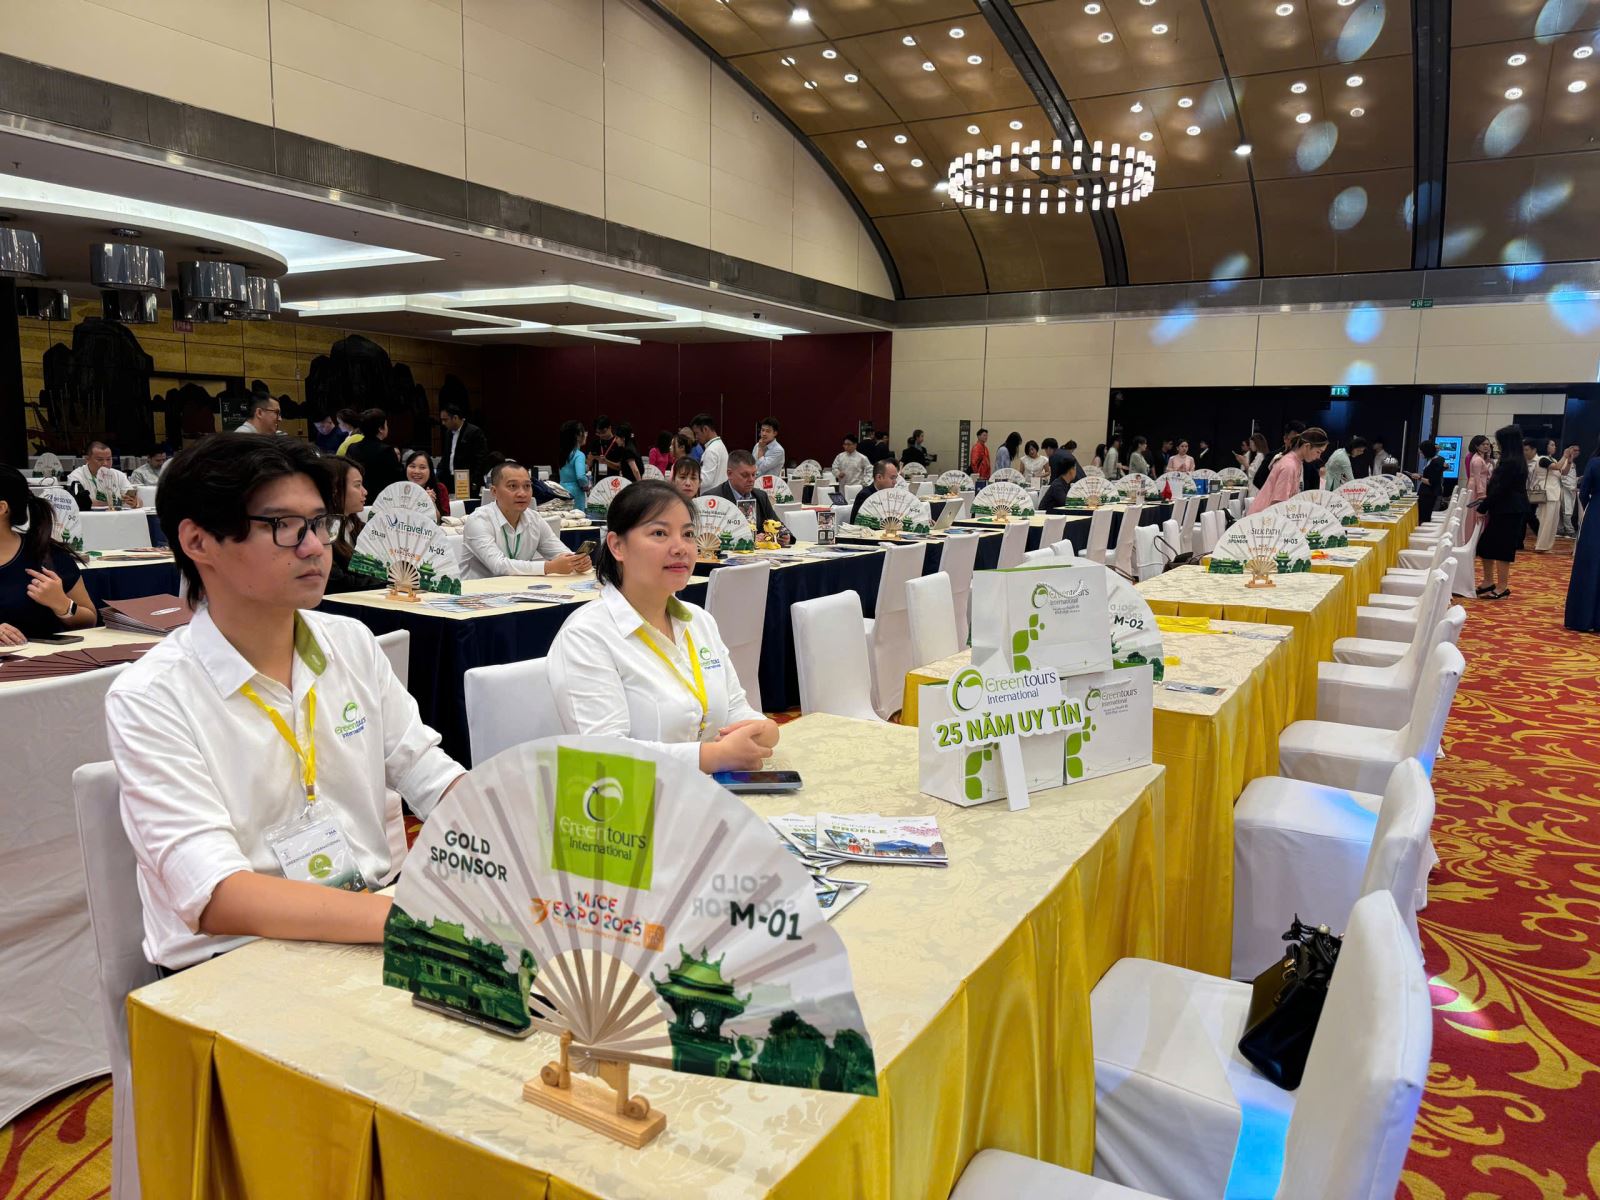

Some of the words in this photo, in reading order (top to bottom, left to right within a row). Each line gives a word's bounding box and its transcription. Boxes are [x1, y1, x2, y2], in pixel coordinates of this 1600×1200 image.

[428, 545, 445, 556] N-02
[1113, 614, 1144, 631] M-02
[984, 671, 1057, 693] Greentours
[987, 688, 1040, 705] International
[935, 722, 963, 748] 25
[966, 711, 1016, 742] NĂM
[1017, 707, 1045, 733] UY
[1046, 699, 1083, 728] TÍN
[444, 829, 491, 856] GOLD
[559, 815, 647, 850] Greentours
[569, 836, 632, 861] International
[430, 845, 508, 883] SPONSOR
[576, 890, 619, 914] MICE
[552, 900, 601, 926] EXPO
[602, 913, 643, 937] 2025
[729, 900, 803, 941] M-01
